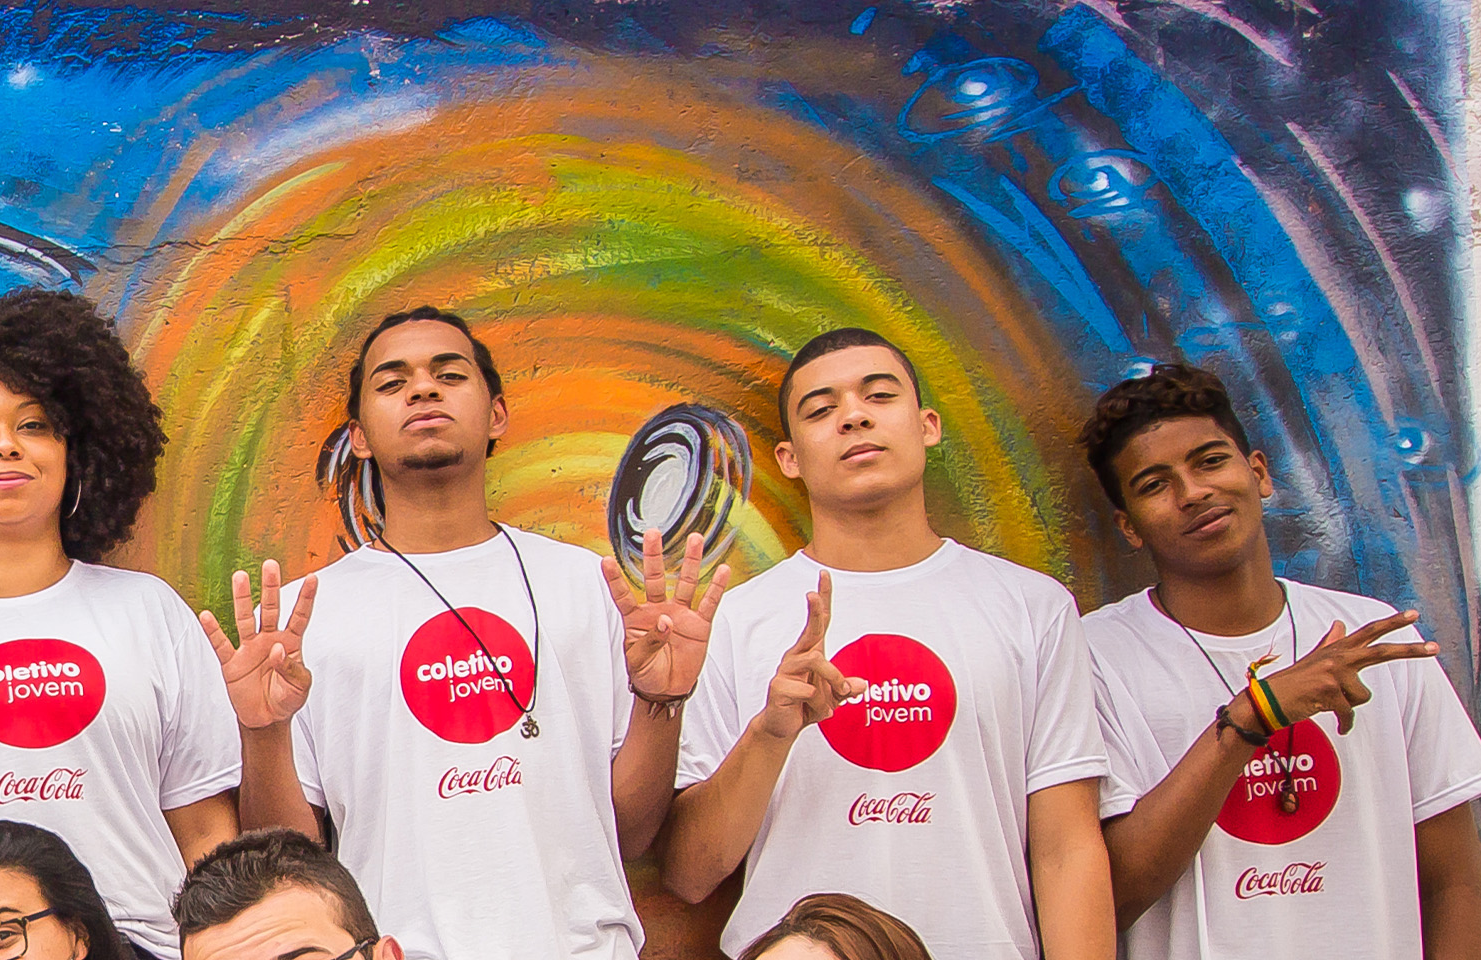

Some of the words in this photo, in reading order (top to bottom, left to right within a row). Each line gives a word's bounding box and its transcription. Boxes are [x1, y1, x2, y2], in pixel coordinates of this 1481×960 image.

[416, 649, 513, 682] coletivo
[7, 681, 84, 704] jovem
[448, 675, 513, 703] jovem
[838, 678, 932, 706] letivo
[865, 703, 932, 726] jovem
[438, 755, 523, 800] Coca-Cola
[847, 791, 937, 826] Coca-Cola
[1235, 861, 1329, 900] Coca-Cola
